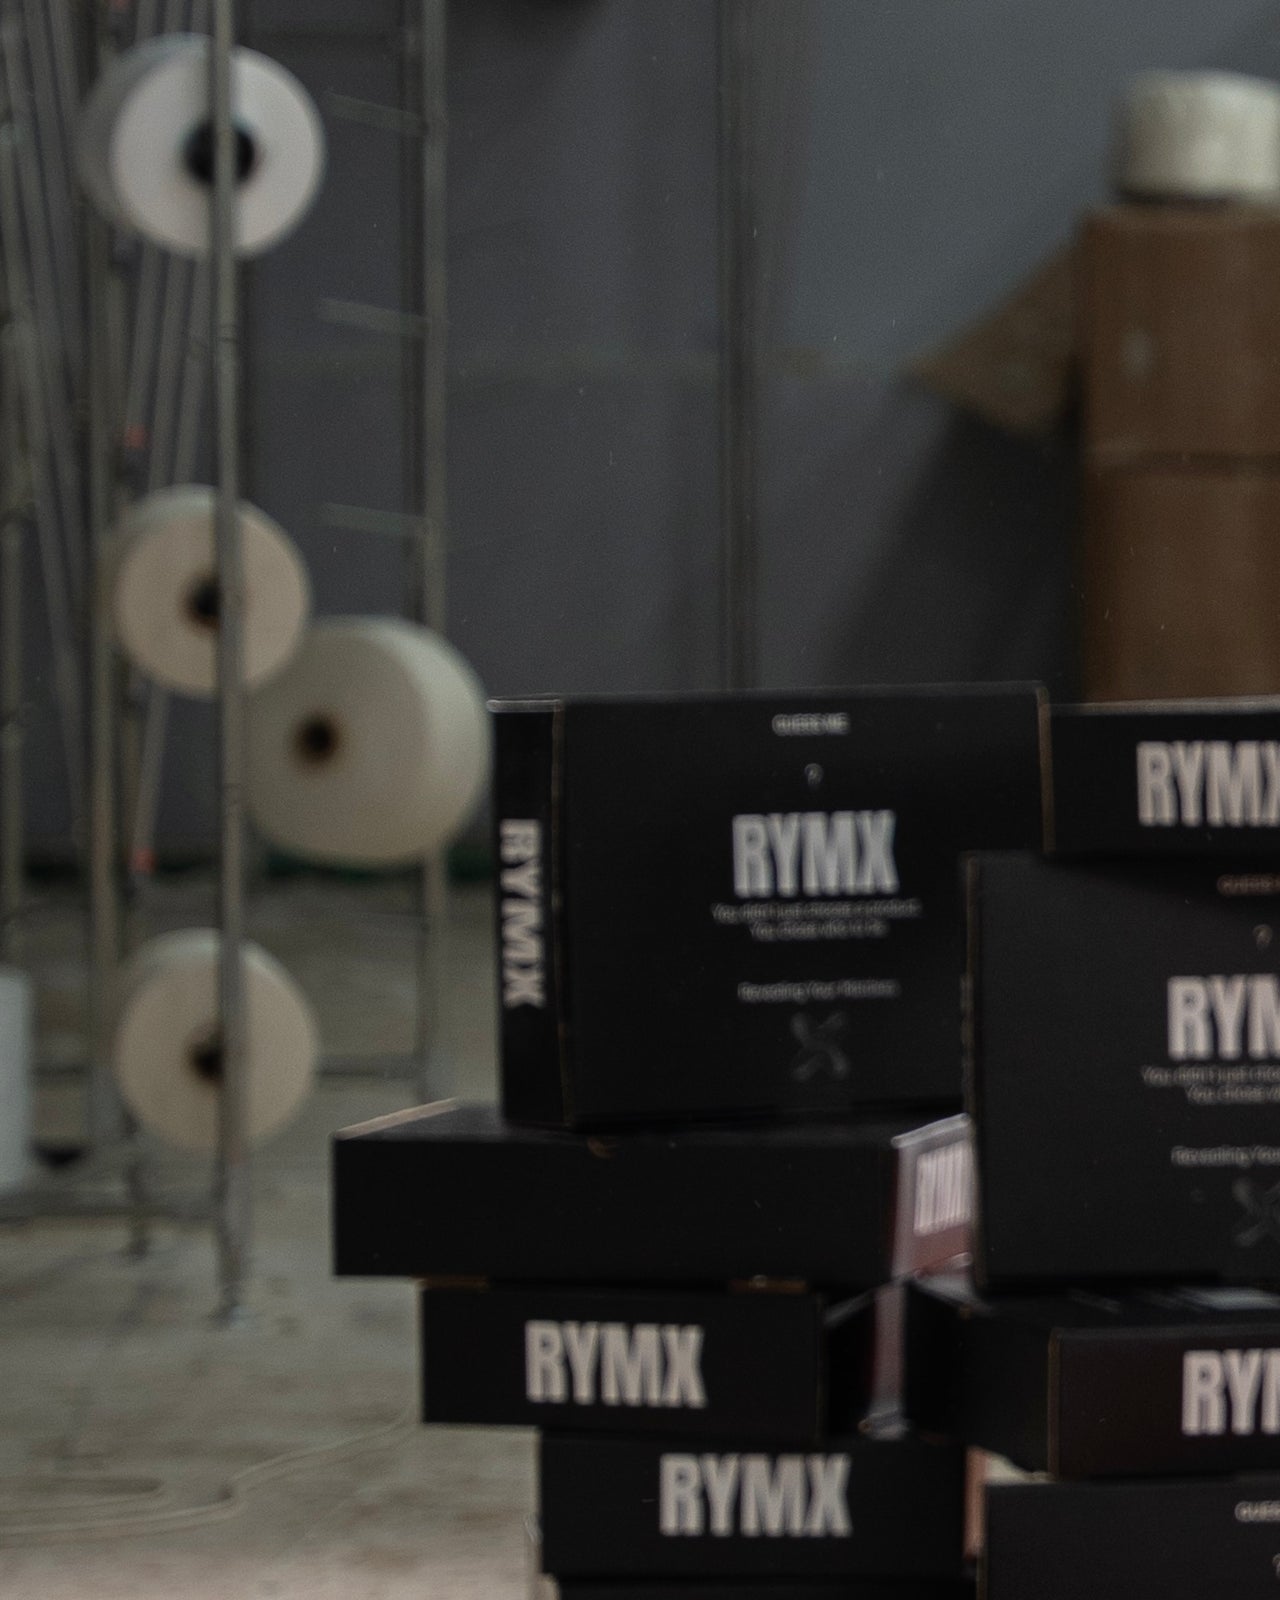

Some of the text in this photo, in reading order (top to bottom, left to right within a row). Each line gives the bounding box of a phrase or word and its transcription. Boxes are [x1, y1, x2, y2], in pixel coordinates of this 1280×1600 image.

[732, 809, 899, 898] RYMX
[501, 819, 544, 1009] RYMX
[524, 1319, 706, 1409] RYMX
[659, 1453, 851, 1537] RYMX
